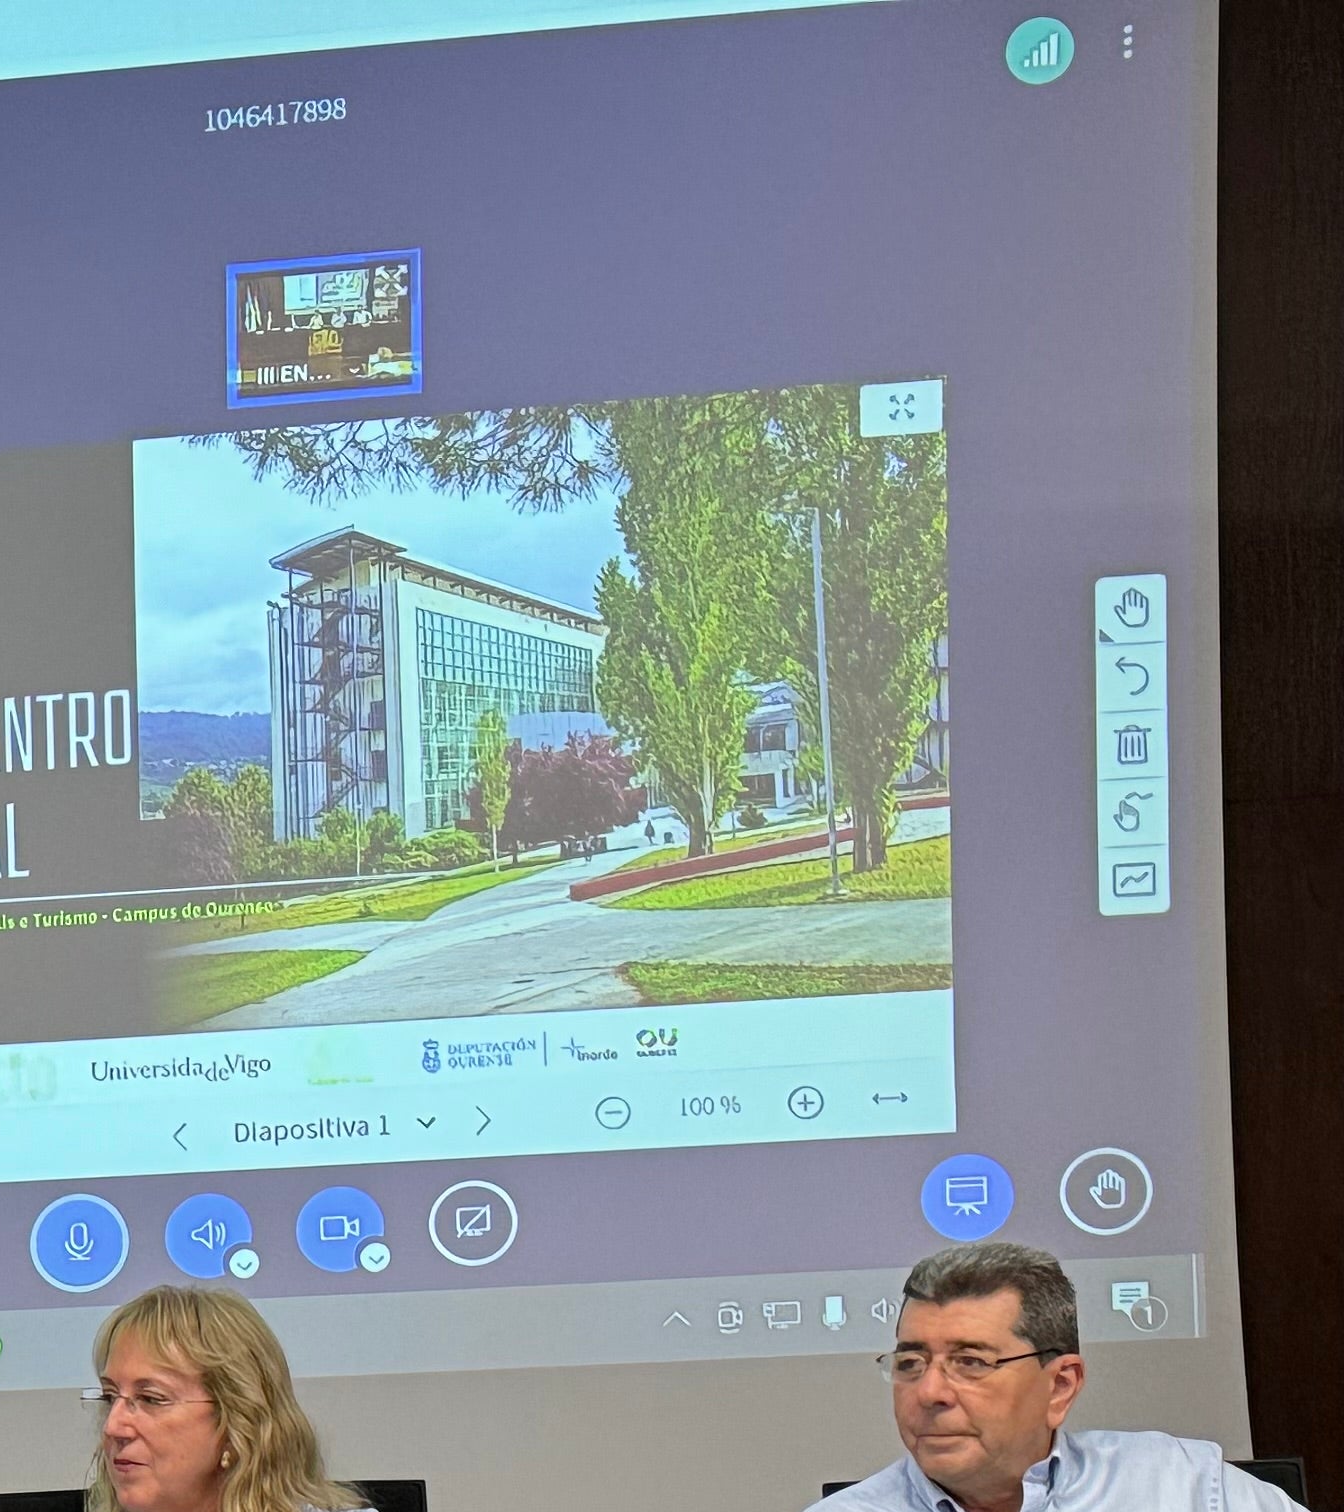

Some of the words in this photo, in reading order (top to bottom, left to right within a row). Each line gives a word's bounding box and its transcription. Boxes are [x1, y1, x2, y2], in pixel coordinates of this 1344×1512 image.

[204, 95, 347, 133] 1046417898
[20, 918, 29, 930] e
[32, 910, 97, 930] Turismo
[112, 907, 177, 924] Campus
[182, 902, 201, 918] de
[680, 1096, 713, 1117] 100
[719, 1095, 742, 1115] %
[235, 1117, 369, 1145] Diapositiva
[379, 1115, 391, 1136] 1
